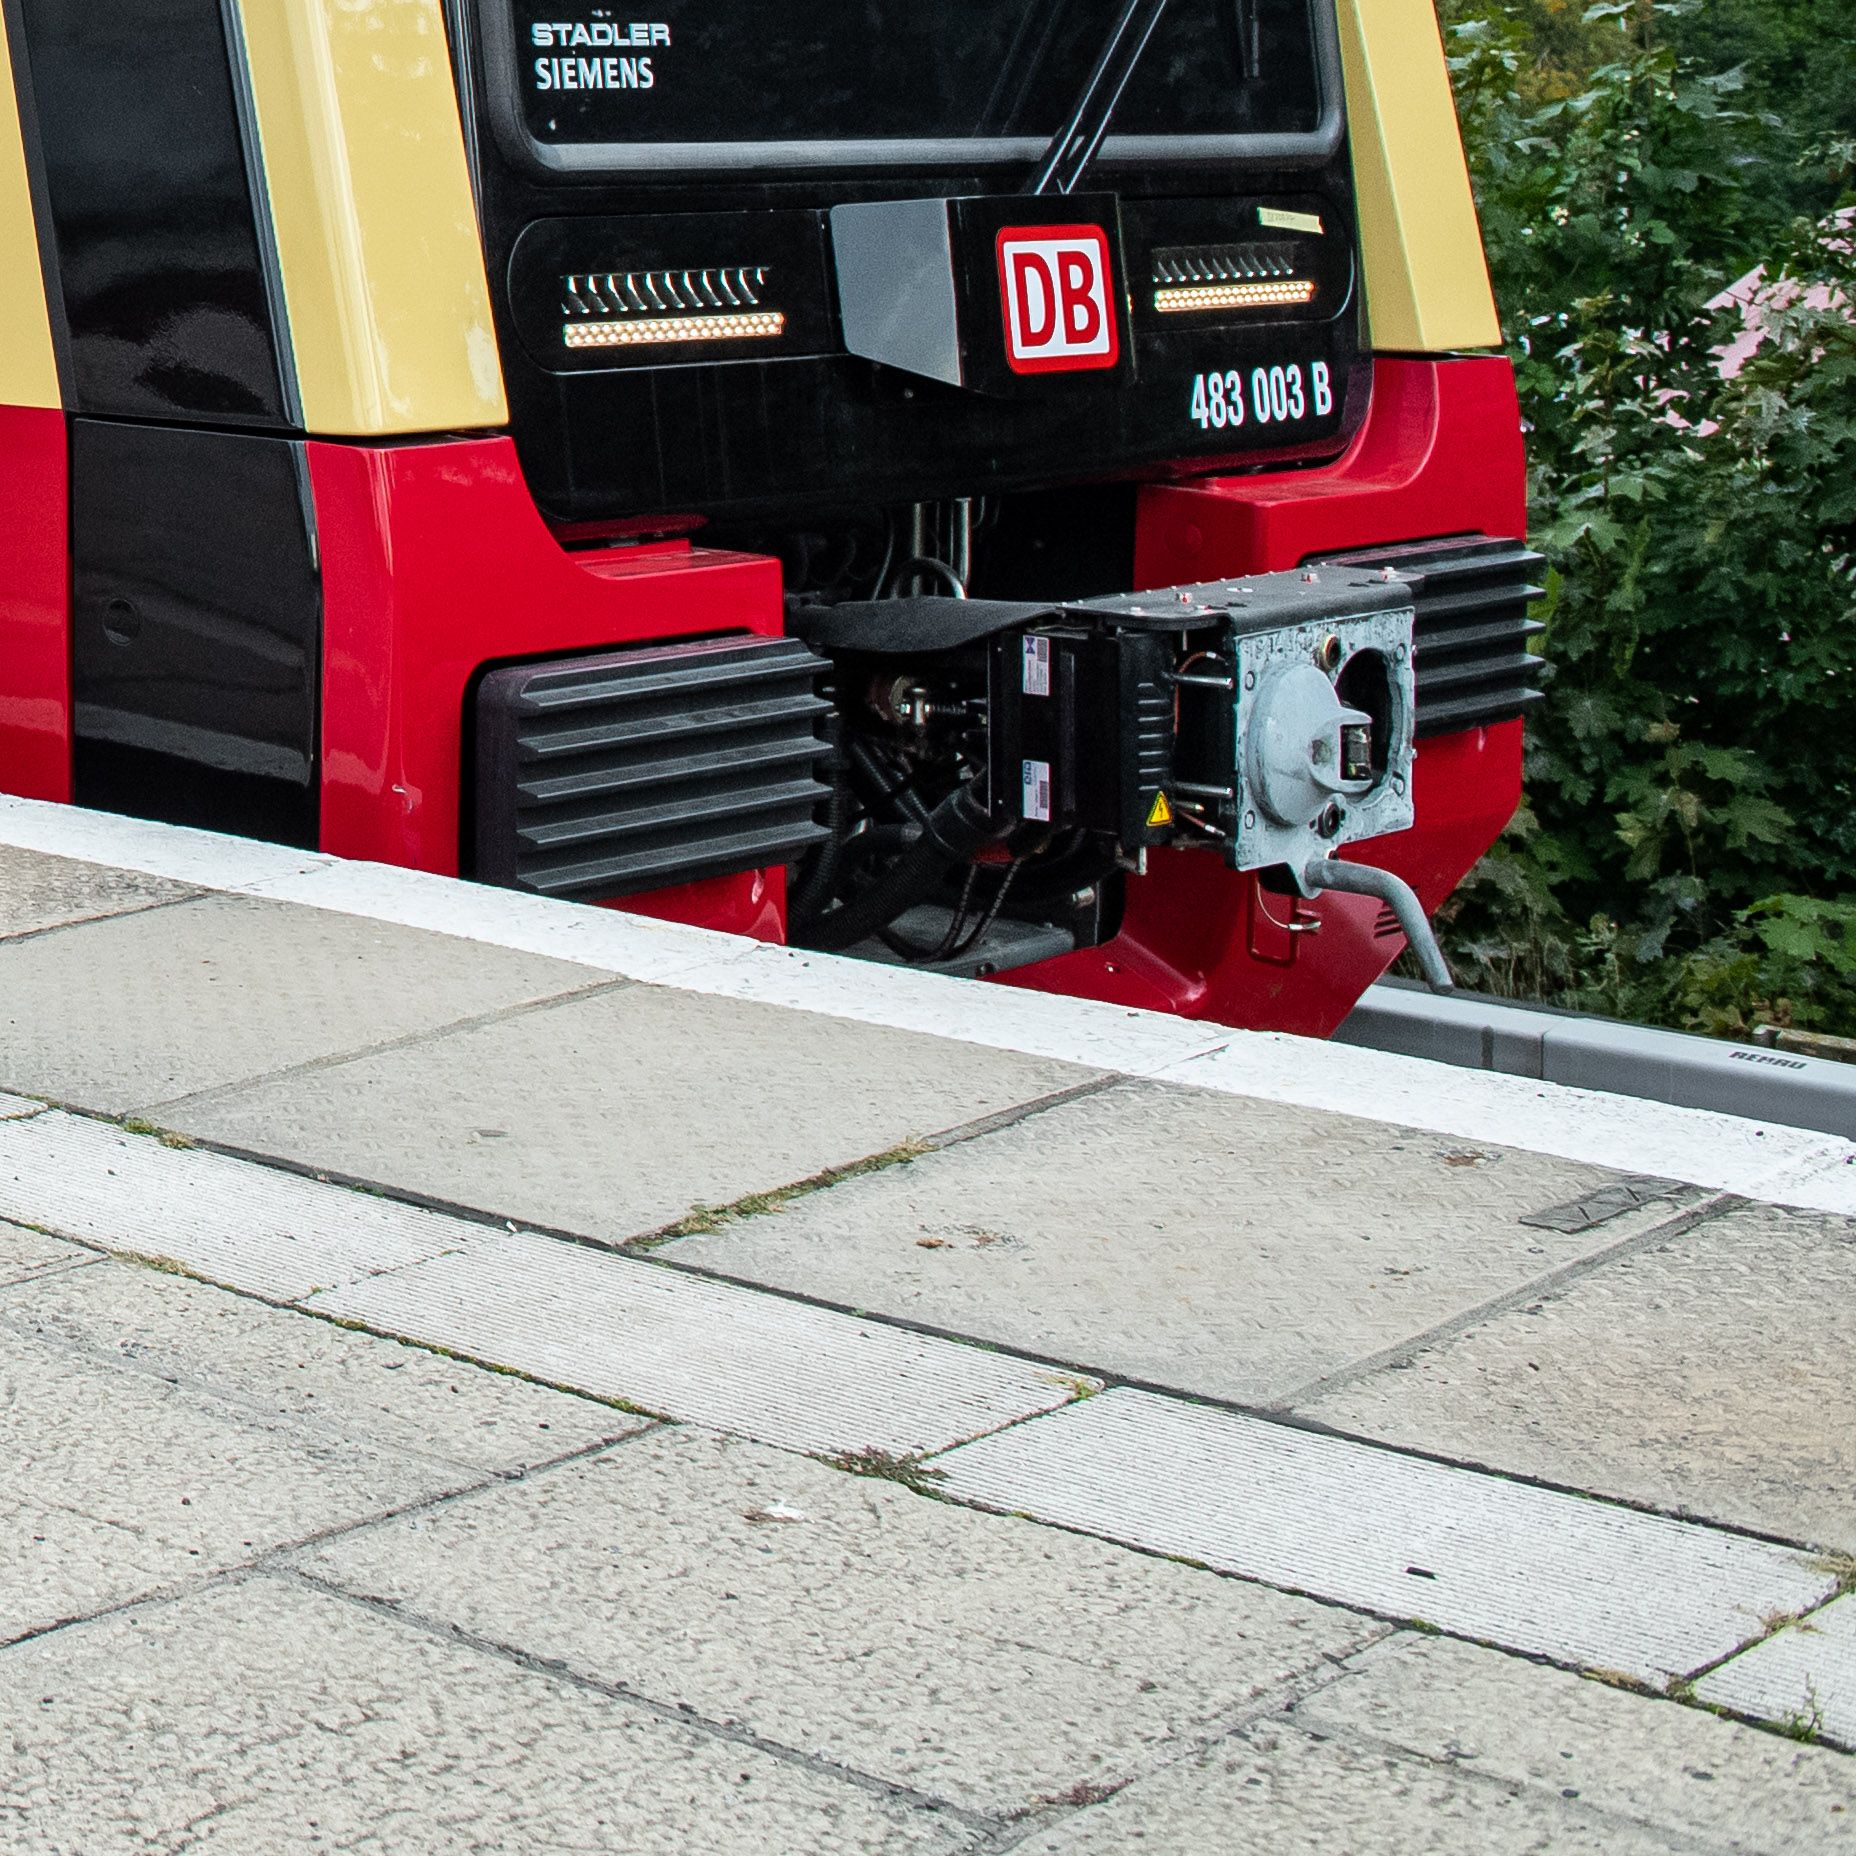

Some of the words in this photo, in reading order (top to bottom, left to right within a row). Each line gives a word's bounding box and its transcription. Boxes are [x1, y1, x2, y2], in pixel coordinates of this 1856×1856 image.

[531, 23, 671, 46] STADLER
[535, 57, 654, 90] SIEMENS
[1012, 250, 1101, 347] DB
[1191, 370, 1245, 429] 483
[1252, 363, 1305, 424] 003
[1311, 361, 1333, 416] B
